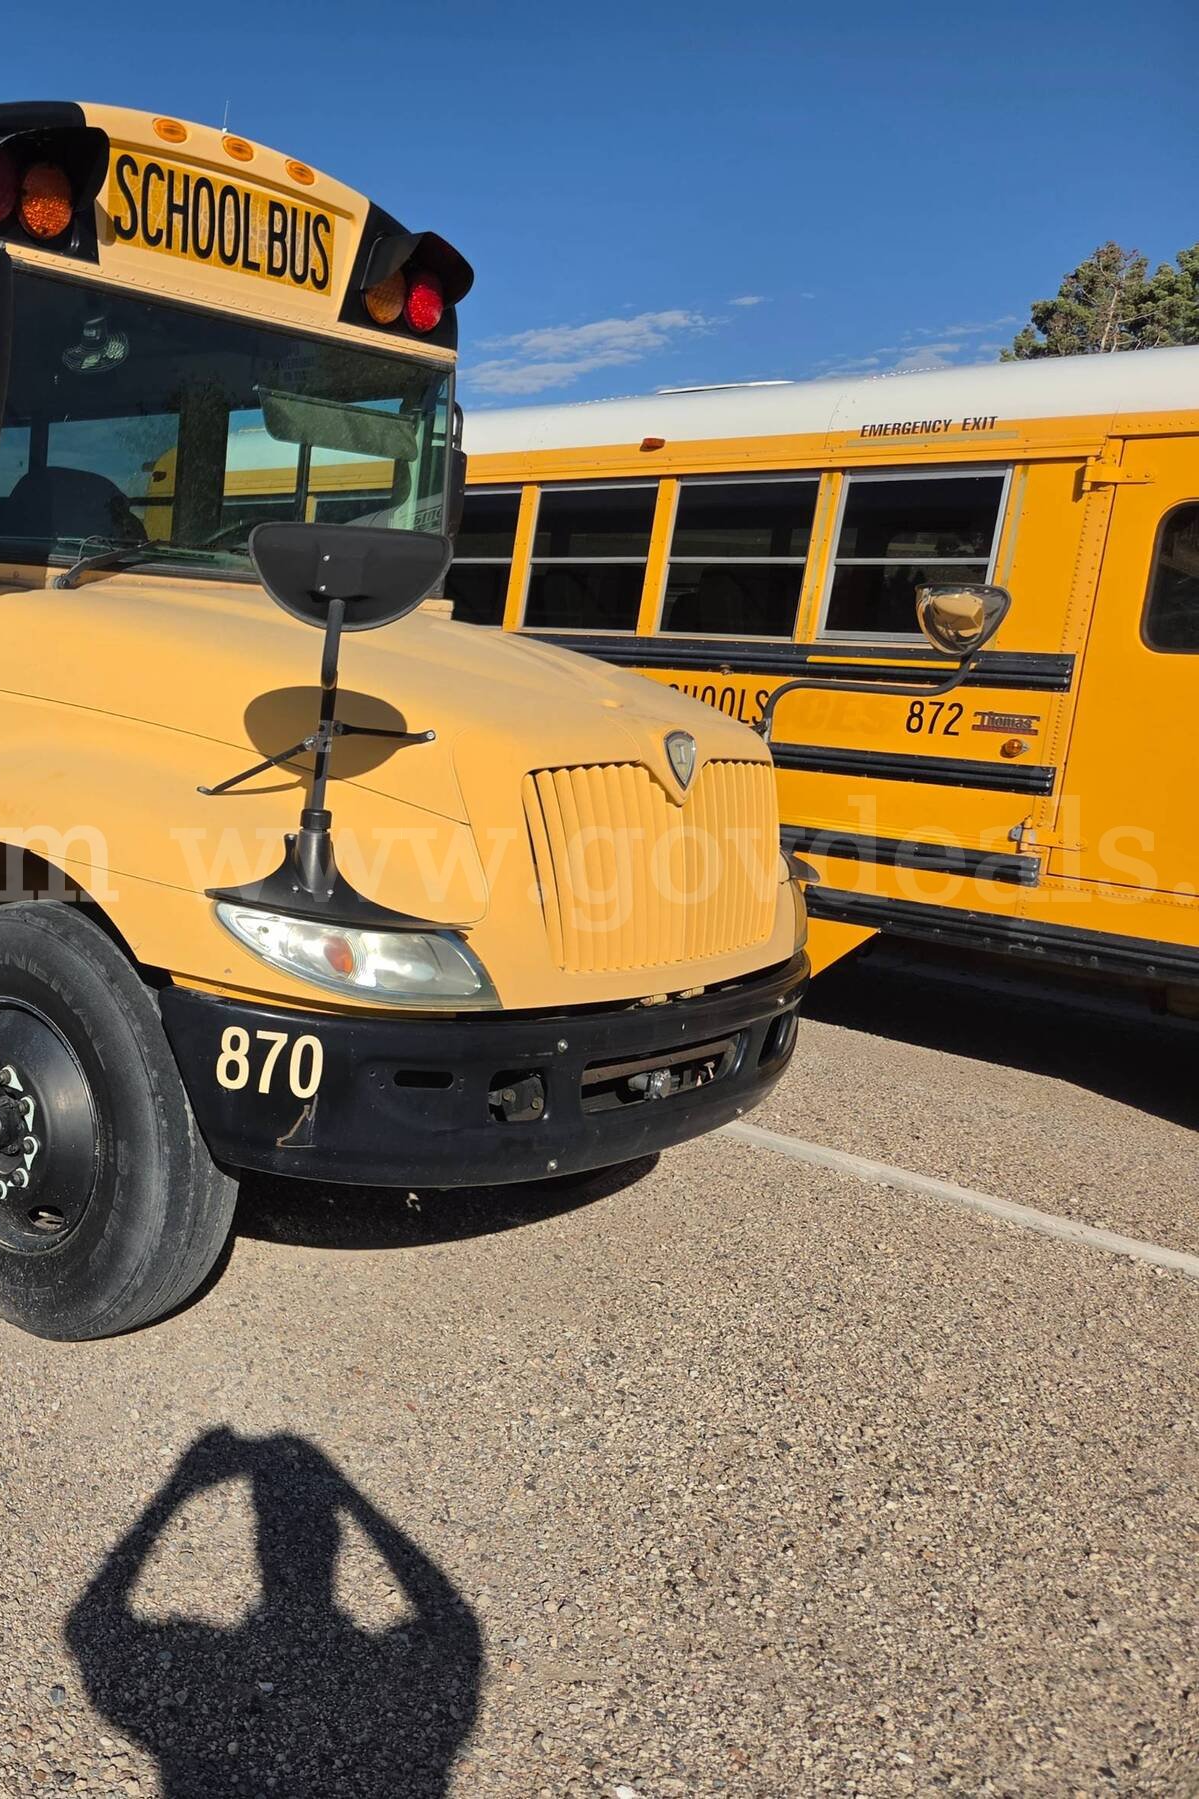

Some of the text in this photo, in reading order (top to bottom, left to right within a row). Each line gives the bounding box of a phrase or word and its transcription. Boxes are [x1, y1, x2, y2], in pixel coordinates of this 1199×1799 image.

[113, 154, 332, 290] SCHOOL BUS
[860, 416, 999, 438] EMERGENCY EXIT
[905, 700, 964, 736] 872
[215, 1026, 324, 1099] 870
